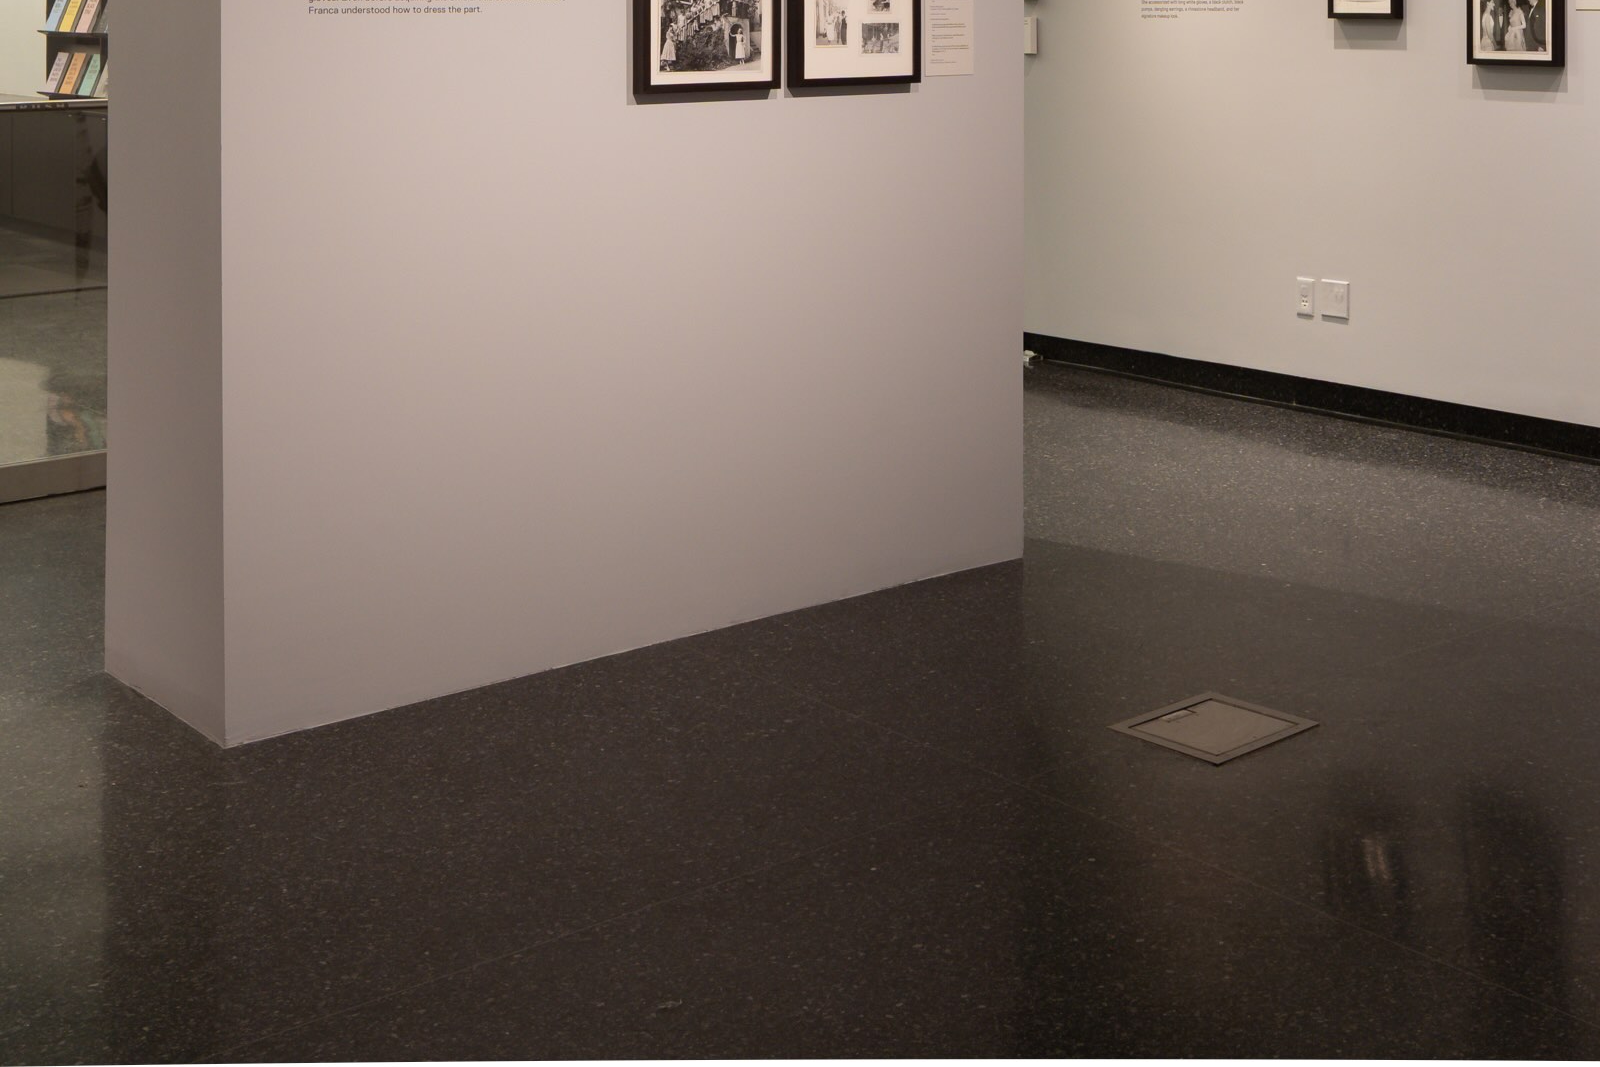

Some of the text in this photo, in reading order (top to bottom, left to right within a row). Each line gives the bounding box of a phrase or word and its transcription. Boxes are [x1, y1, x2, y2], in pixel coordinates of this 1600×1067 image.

[308, 5, 482, 15] Franca understood how to dress the part.
